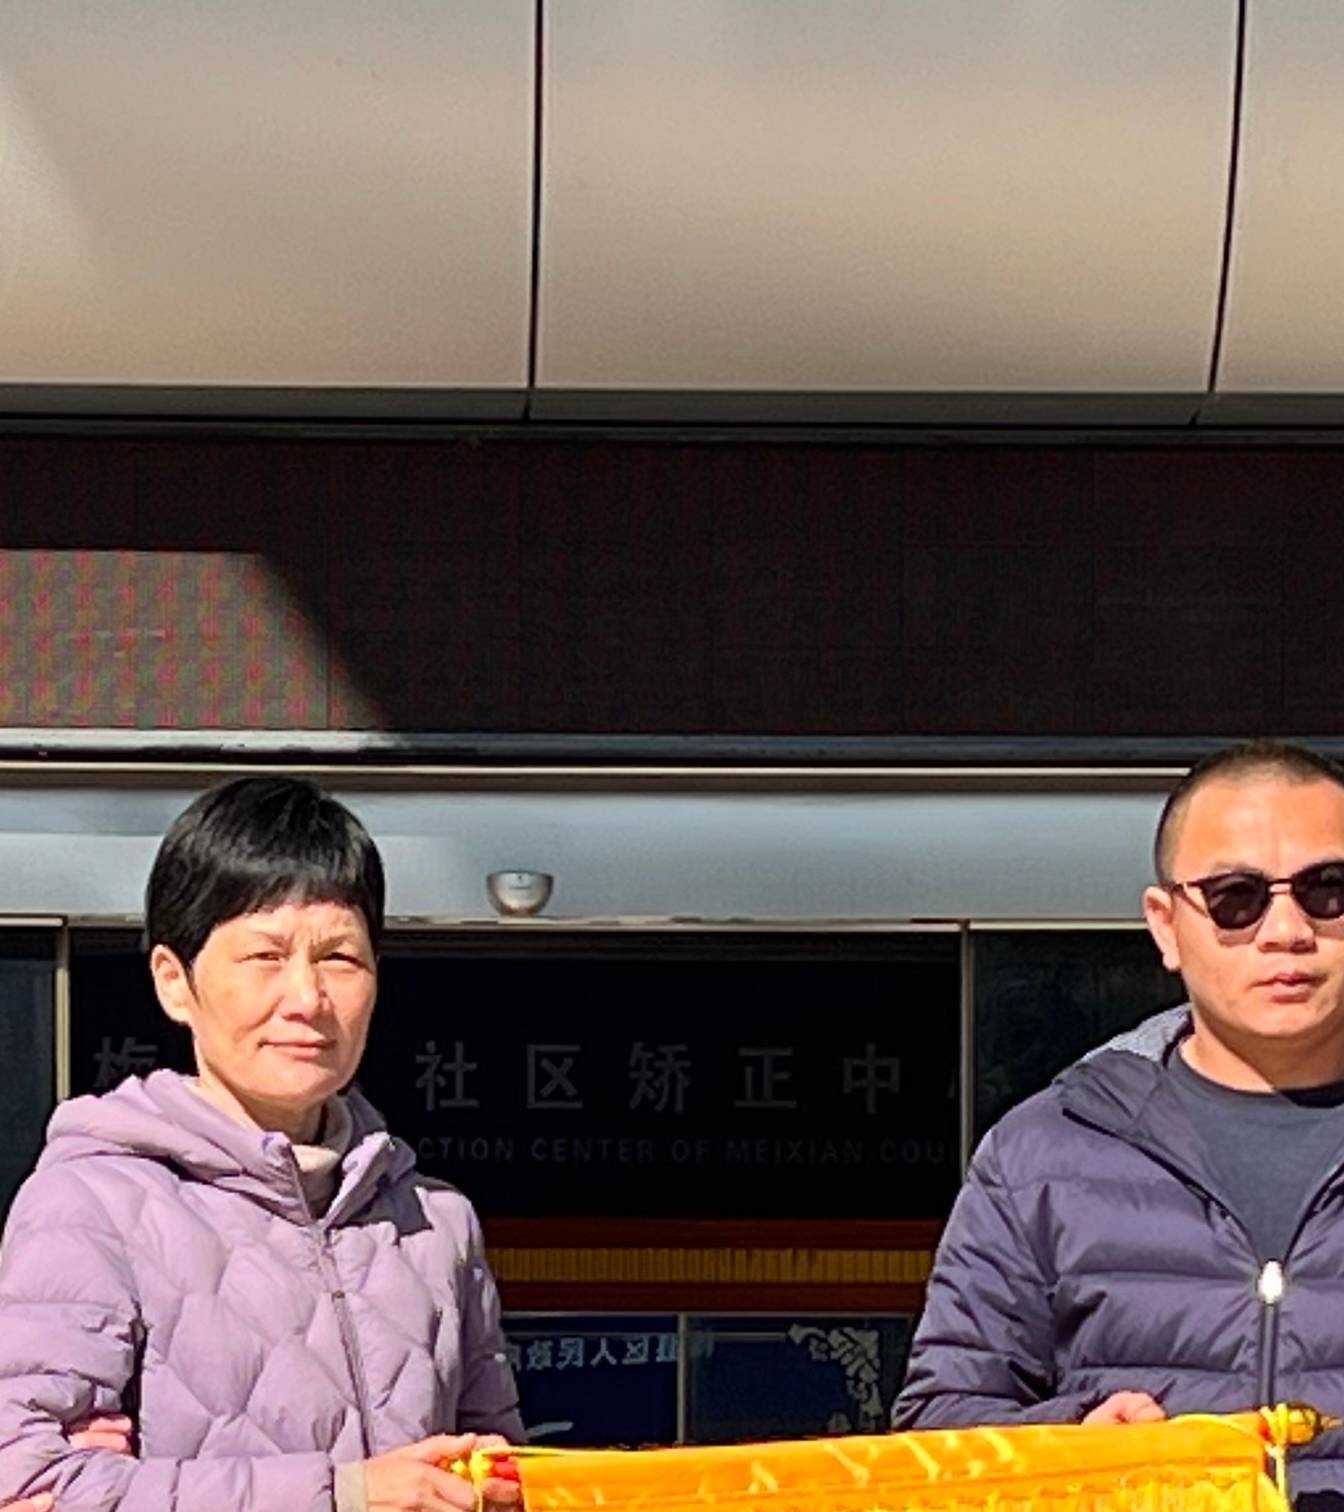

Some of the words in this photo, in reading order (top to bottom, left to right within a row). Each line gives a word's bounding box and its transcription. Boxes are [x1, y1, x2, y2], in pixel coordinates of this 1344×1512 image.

[417, 1136, 516, 1163] CTION
[531, 1136, 657, 1163] CENTER
[671, 1136, 711, 1163] OF
[729, 1136, 866, 1163] MEIXIAN
[879, 1137, 956, 1164] COU
